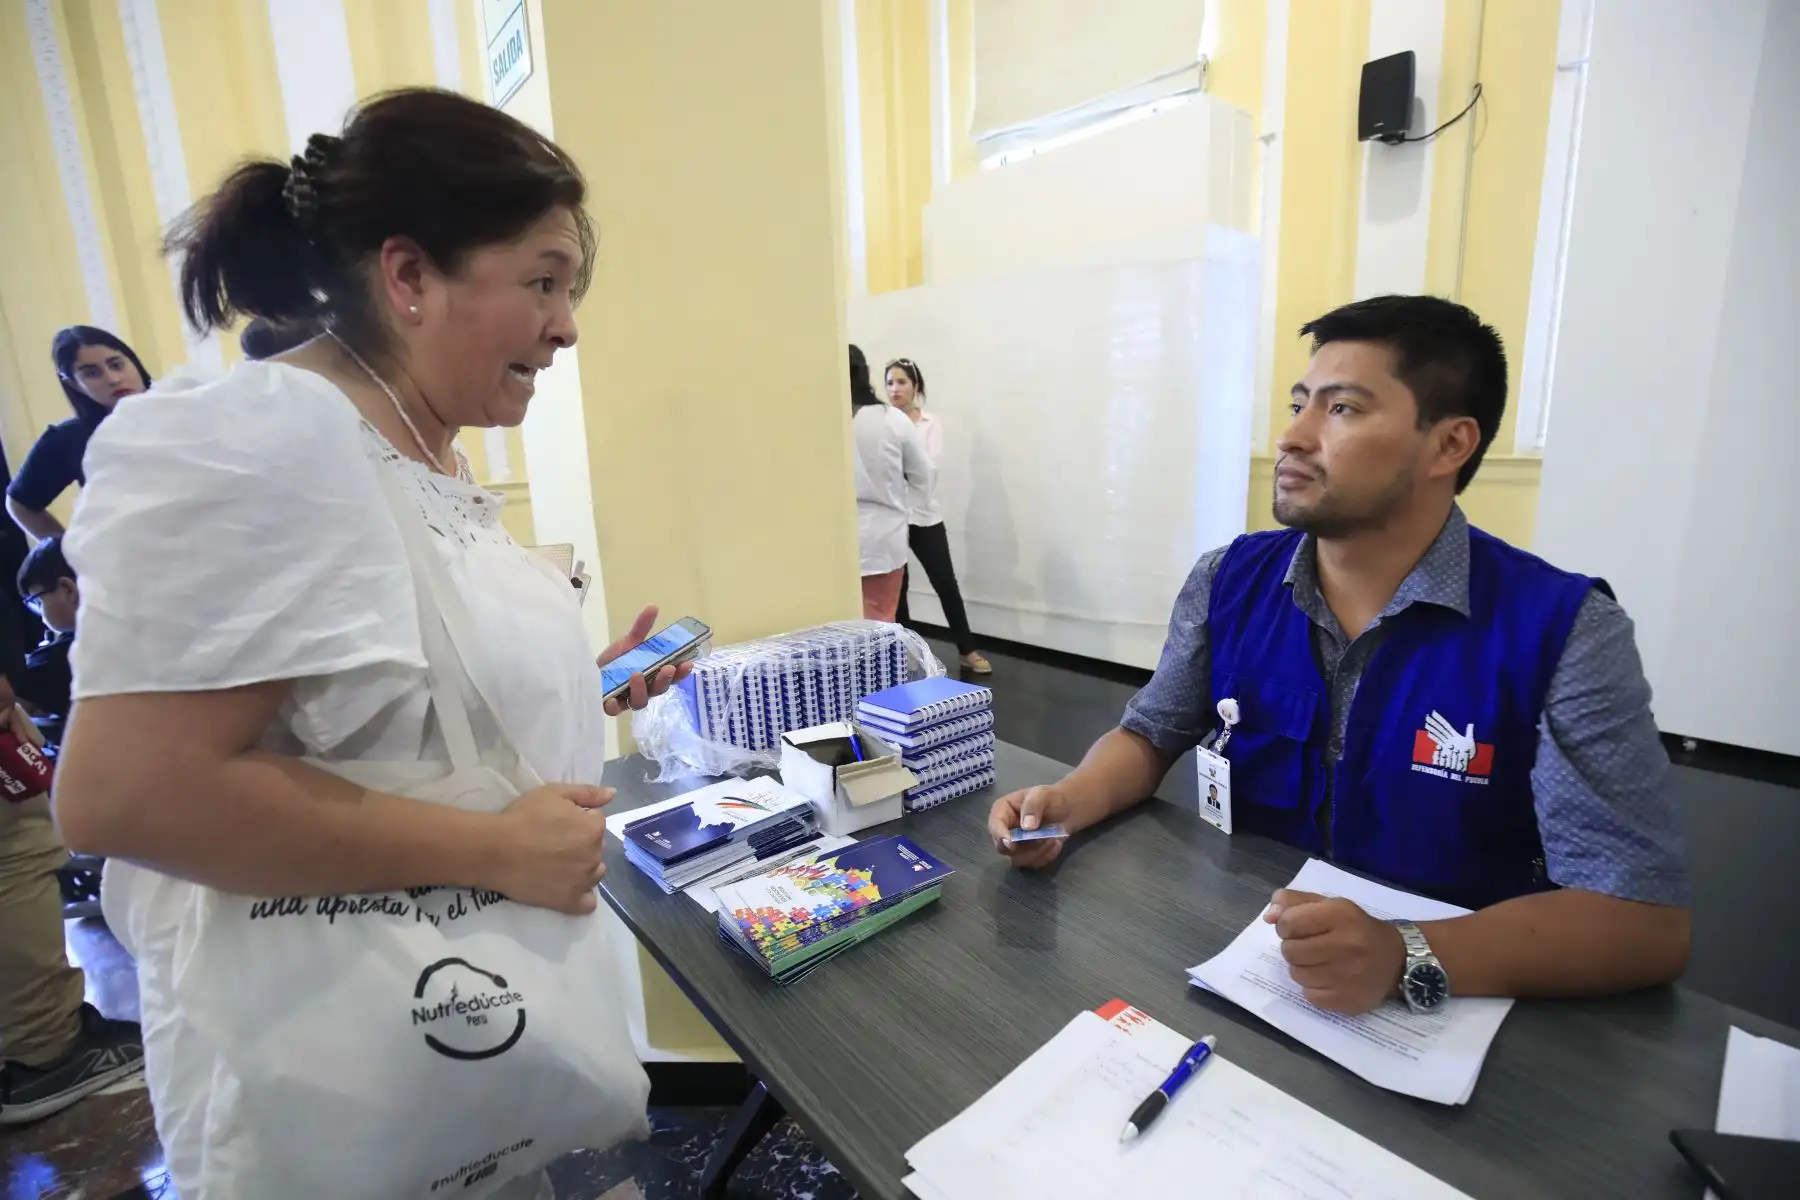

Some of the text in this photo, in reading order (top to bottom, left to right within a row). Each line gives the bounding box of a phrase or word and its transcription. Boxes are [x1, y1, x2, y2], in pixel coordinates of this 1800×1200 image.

[493, 28, 524, 87] SALIDA
[249, 895, 309, 920] una
[316, 894, 410, 925] apuesta
[447, 892, 468, 920] el
